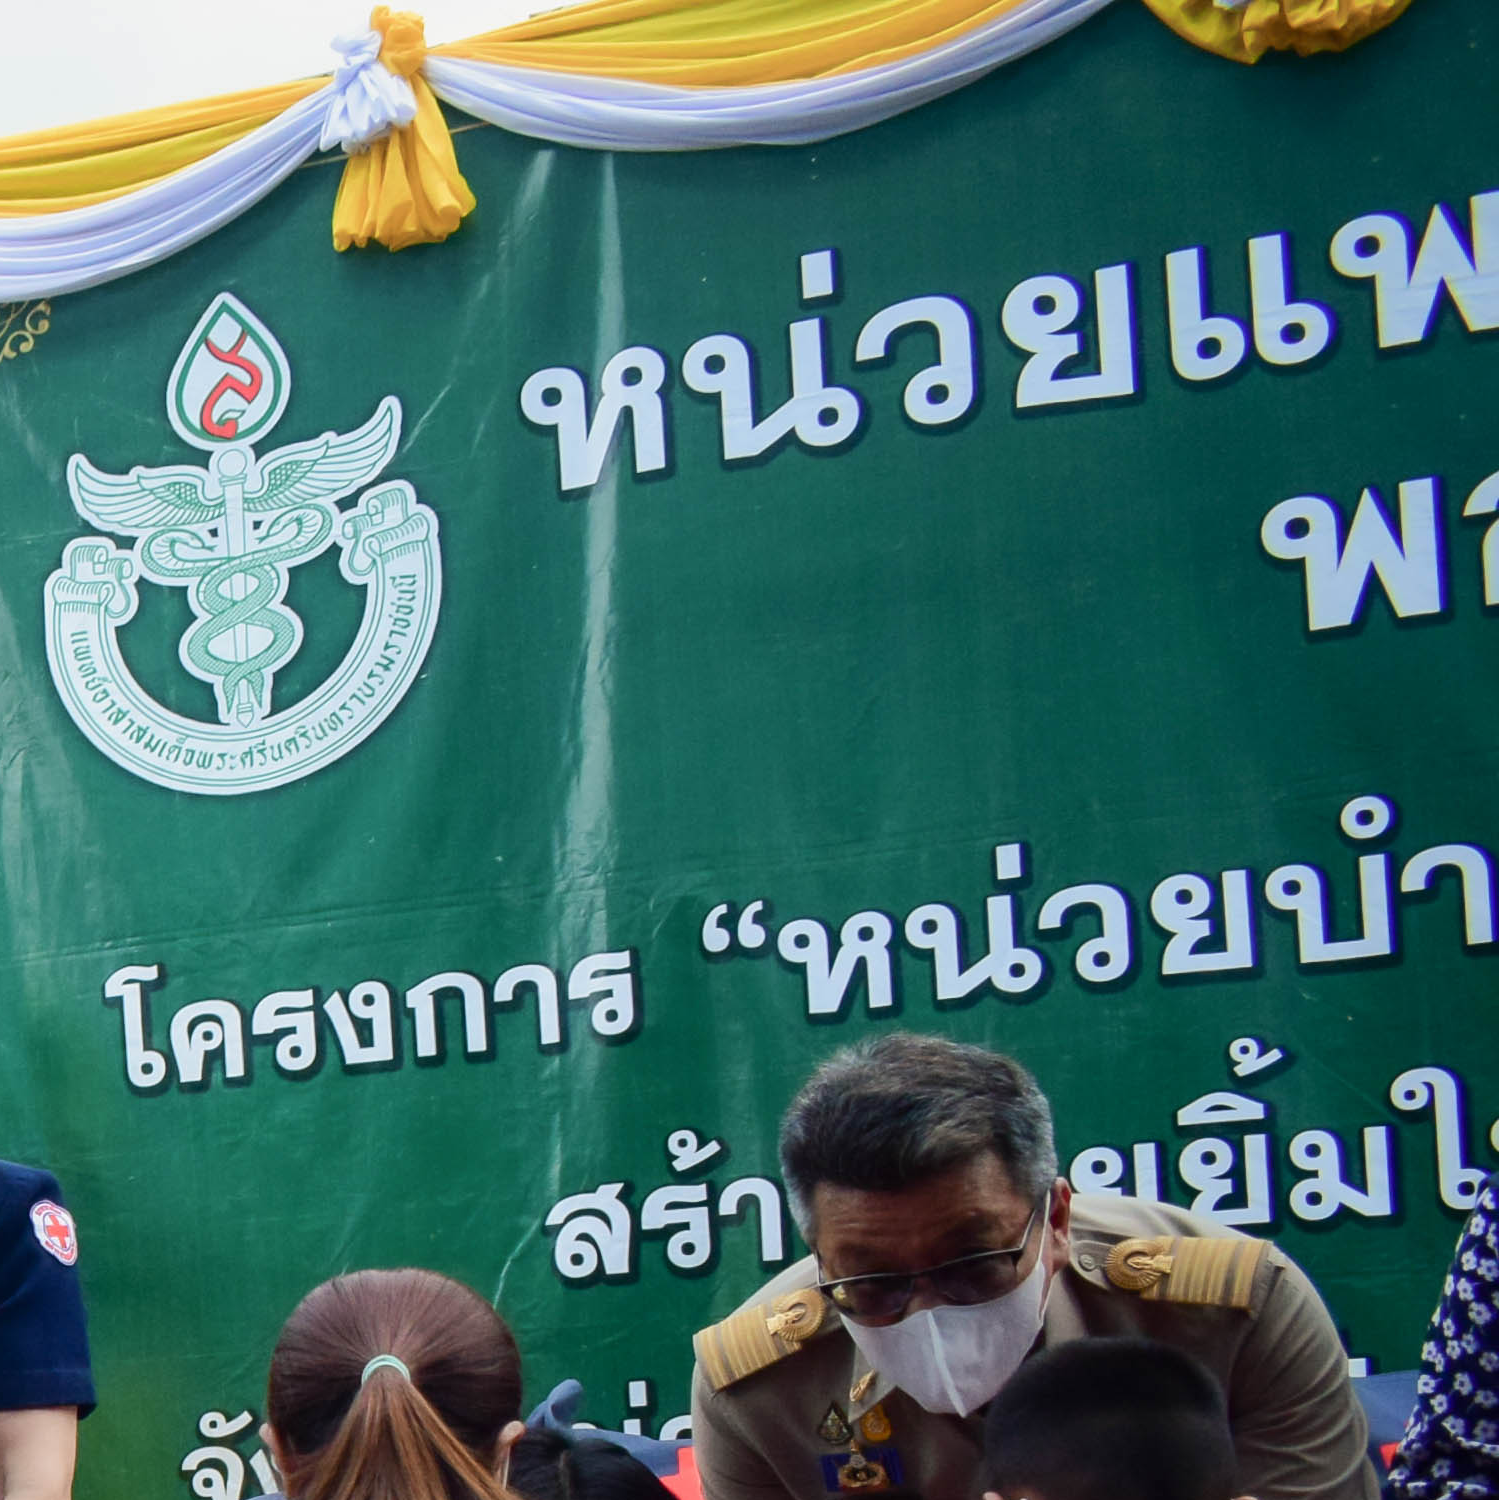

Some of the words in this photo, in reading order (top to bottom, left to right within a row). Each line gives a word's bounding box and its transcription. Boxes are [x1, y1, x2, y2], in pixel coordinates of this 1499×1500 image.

[519, 188, 1499, 491] หน่วยแพ
[104, 949, 635, 1088] โครงการ
